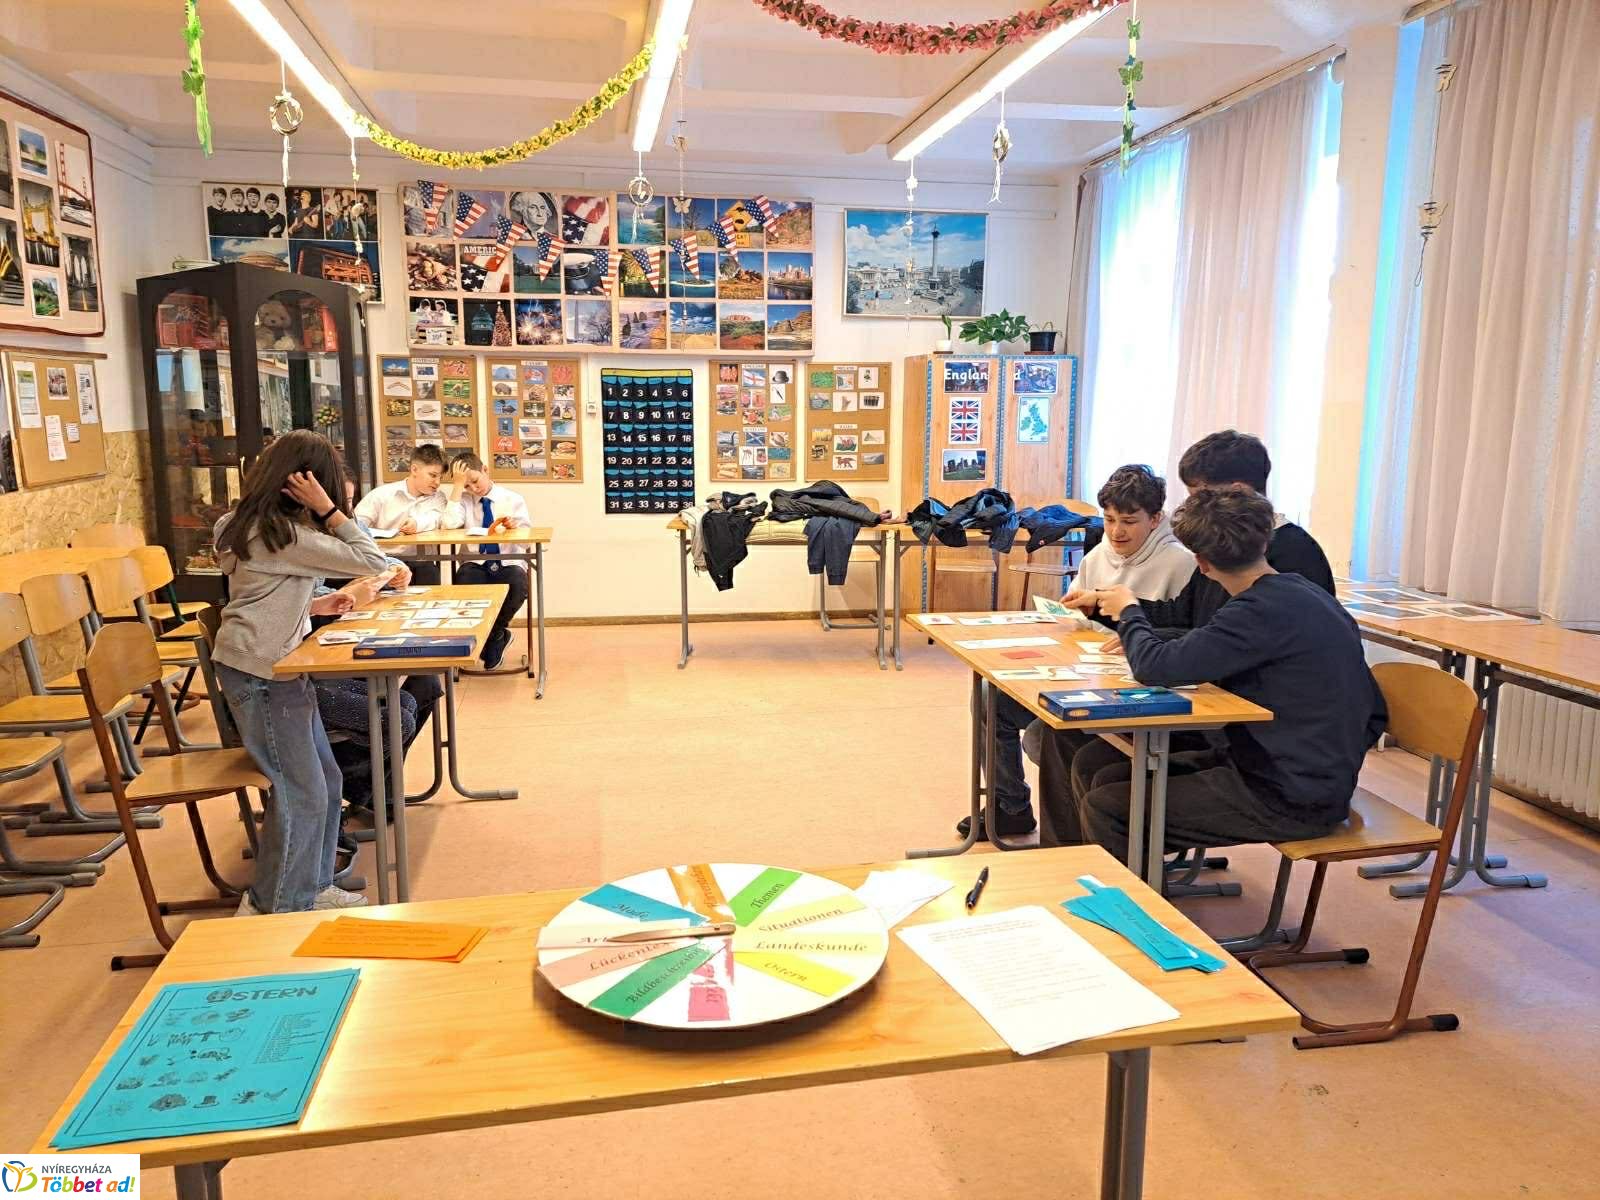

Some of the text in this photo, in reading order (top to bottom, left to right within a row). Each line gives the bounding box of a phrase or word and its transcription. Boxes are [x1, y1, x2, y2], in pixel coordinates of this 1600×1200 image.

[464, 245, 497, 254] AMERIC
[608, 387, 613, 395] 1
[622, 388, 628, 397] 2
[638, 389, 644, 397] 3
[666, 388, 673, 396] 5
[682, 389, 688, 397] 6
[623, 412, 629, 420] 8
[651, 411, 661, 419] 10
[666, 411, 675, 419] 11
[682, 412, 691, 420] 12
[667, 434, 676, 442] 17
[682, 434, 691, 442] 18
[622, 457, 632, 465] 20
[651, 456, 662, 464] 22
[666, 456, 677, 464] 23
[682, 457, 692, 465] 24
[609, 480, 619, 488] 25
[623, 480, 634, 488] 26
[622, 502, 633, 510] 32
[638, 500, 649, 508] 33
[667, 500, 679, 508] 35
[750, 882, 785, 909] Themen
[758, 908, 843, 932] Situationen
[756, 941, 867, 952] Landeskunde
[764, 961, 808, 981] Ostern
